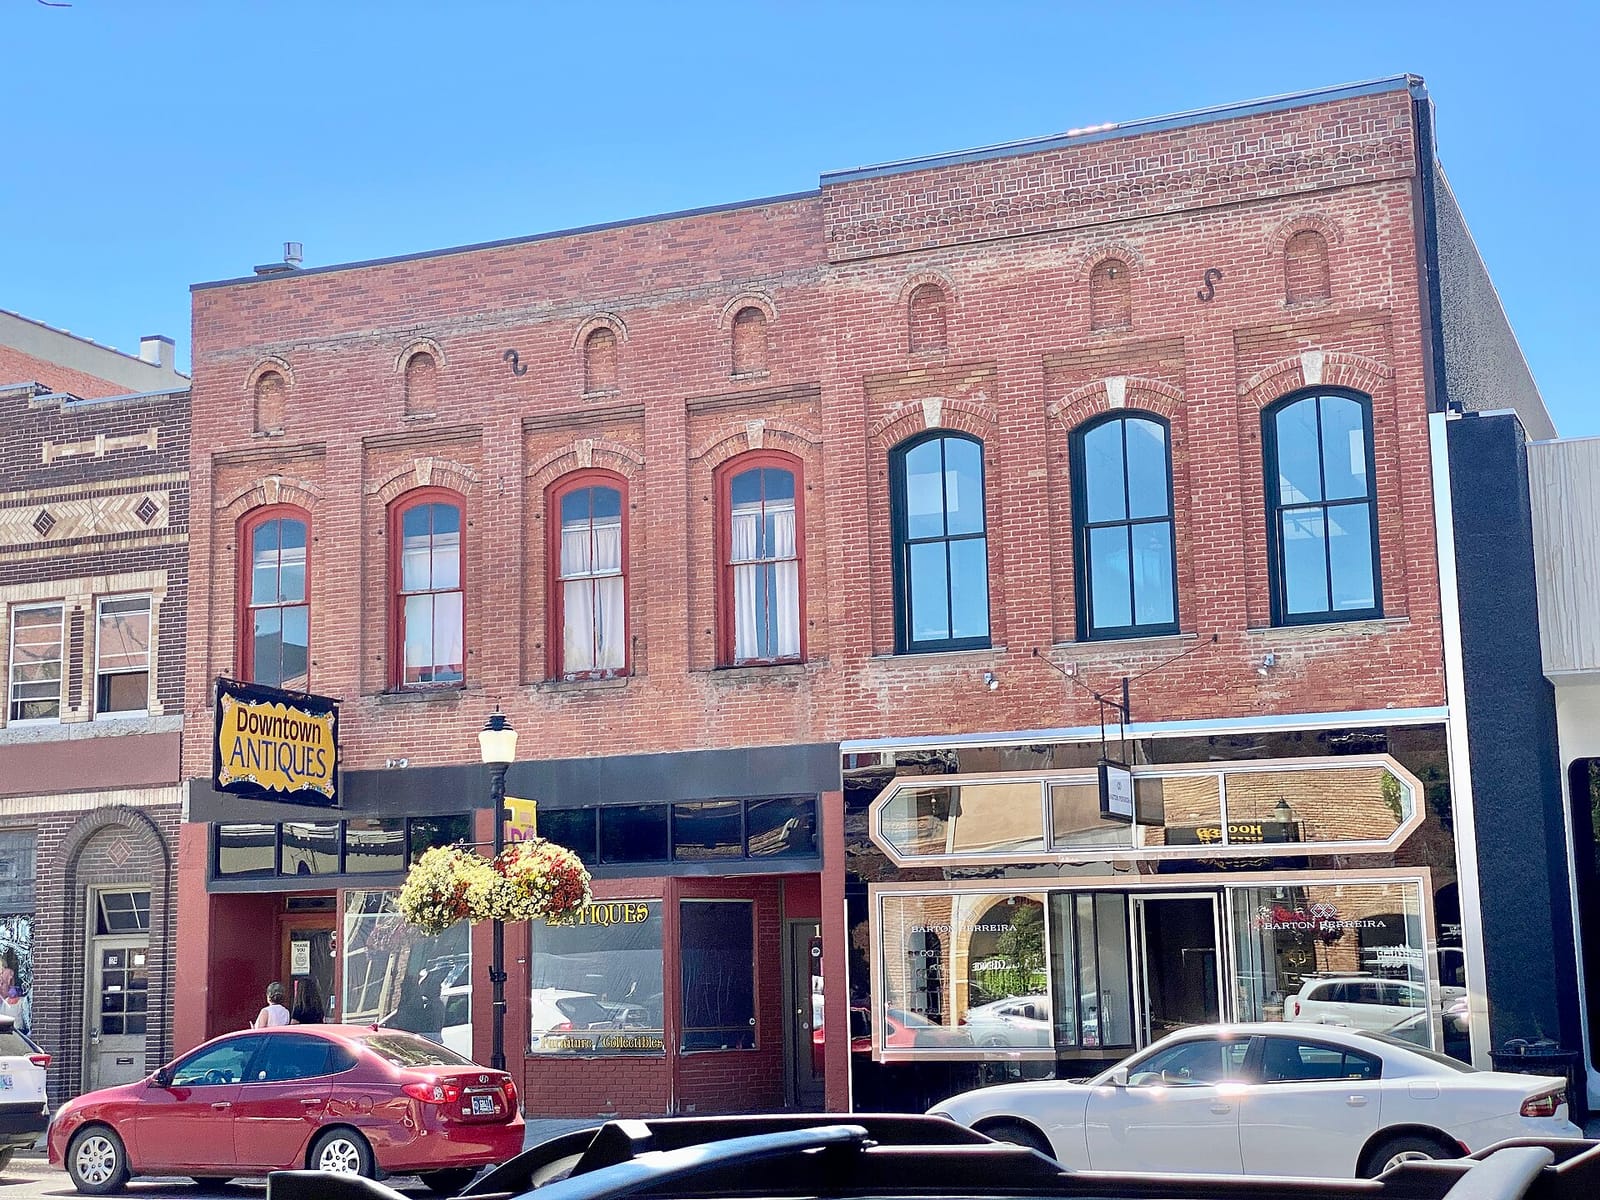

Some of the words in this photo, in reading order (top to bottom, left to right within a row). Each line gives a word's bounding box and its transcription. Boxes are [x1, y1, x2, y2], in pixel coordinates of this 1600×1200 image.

[236, 706, 321, 744] Downtown
[230, 736, 326, 782] ANTIQUES
[911, 924, 955, 933] BARTON
[1264, 921, 1316, 930] BARTON
[602, 1035, 664, 1049] Collectibles
